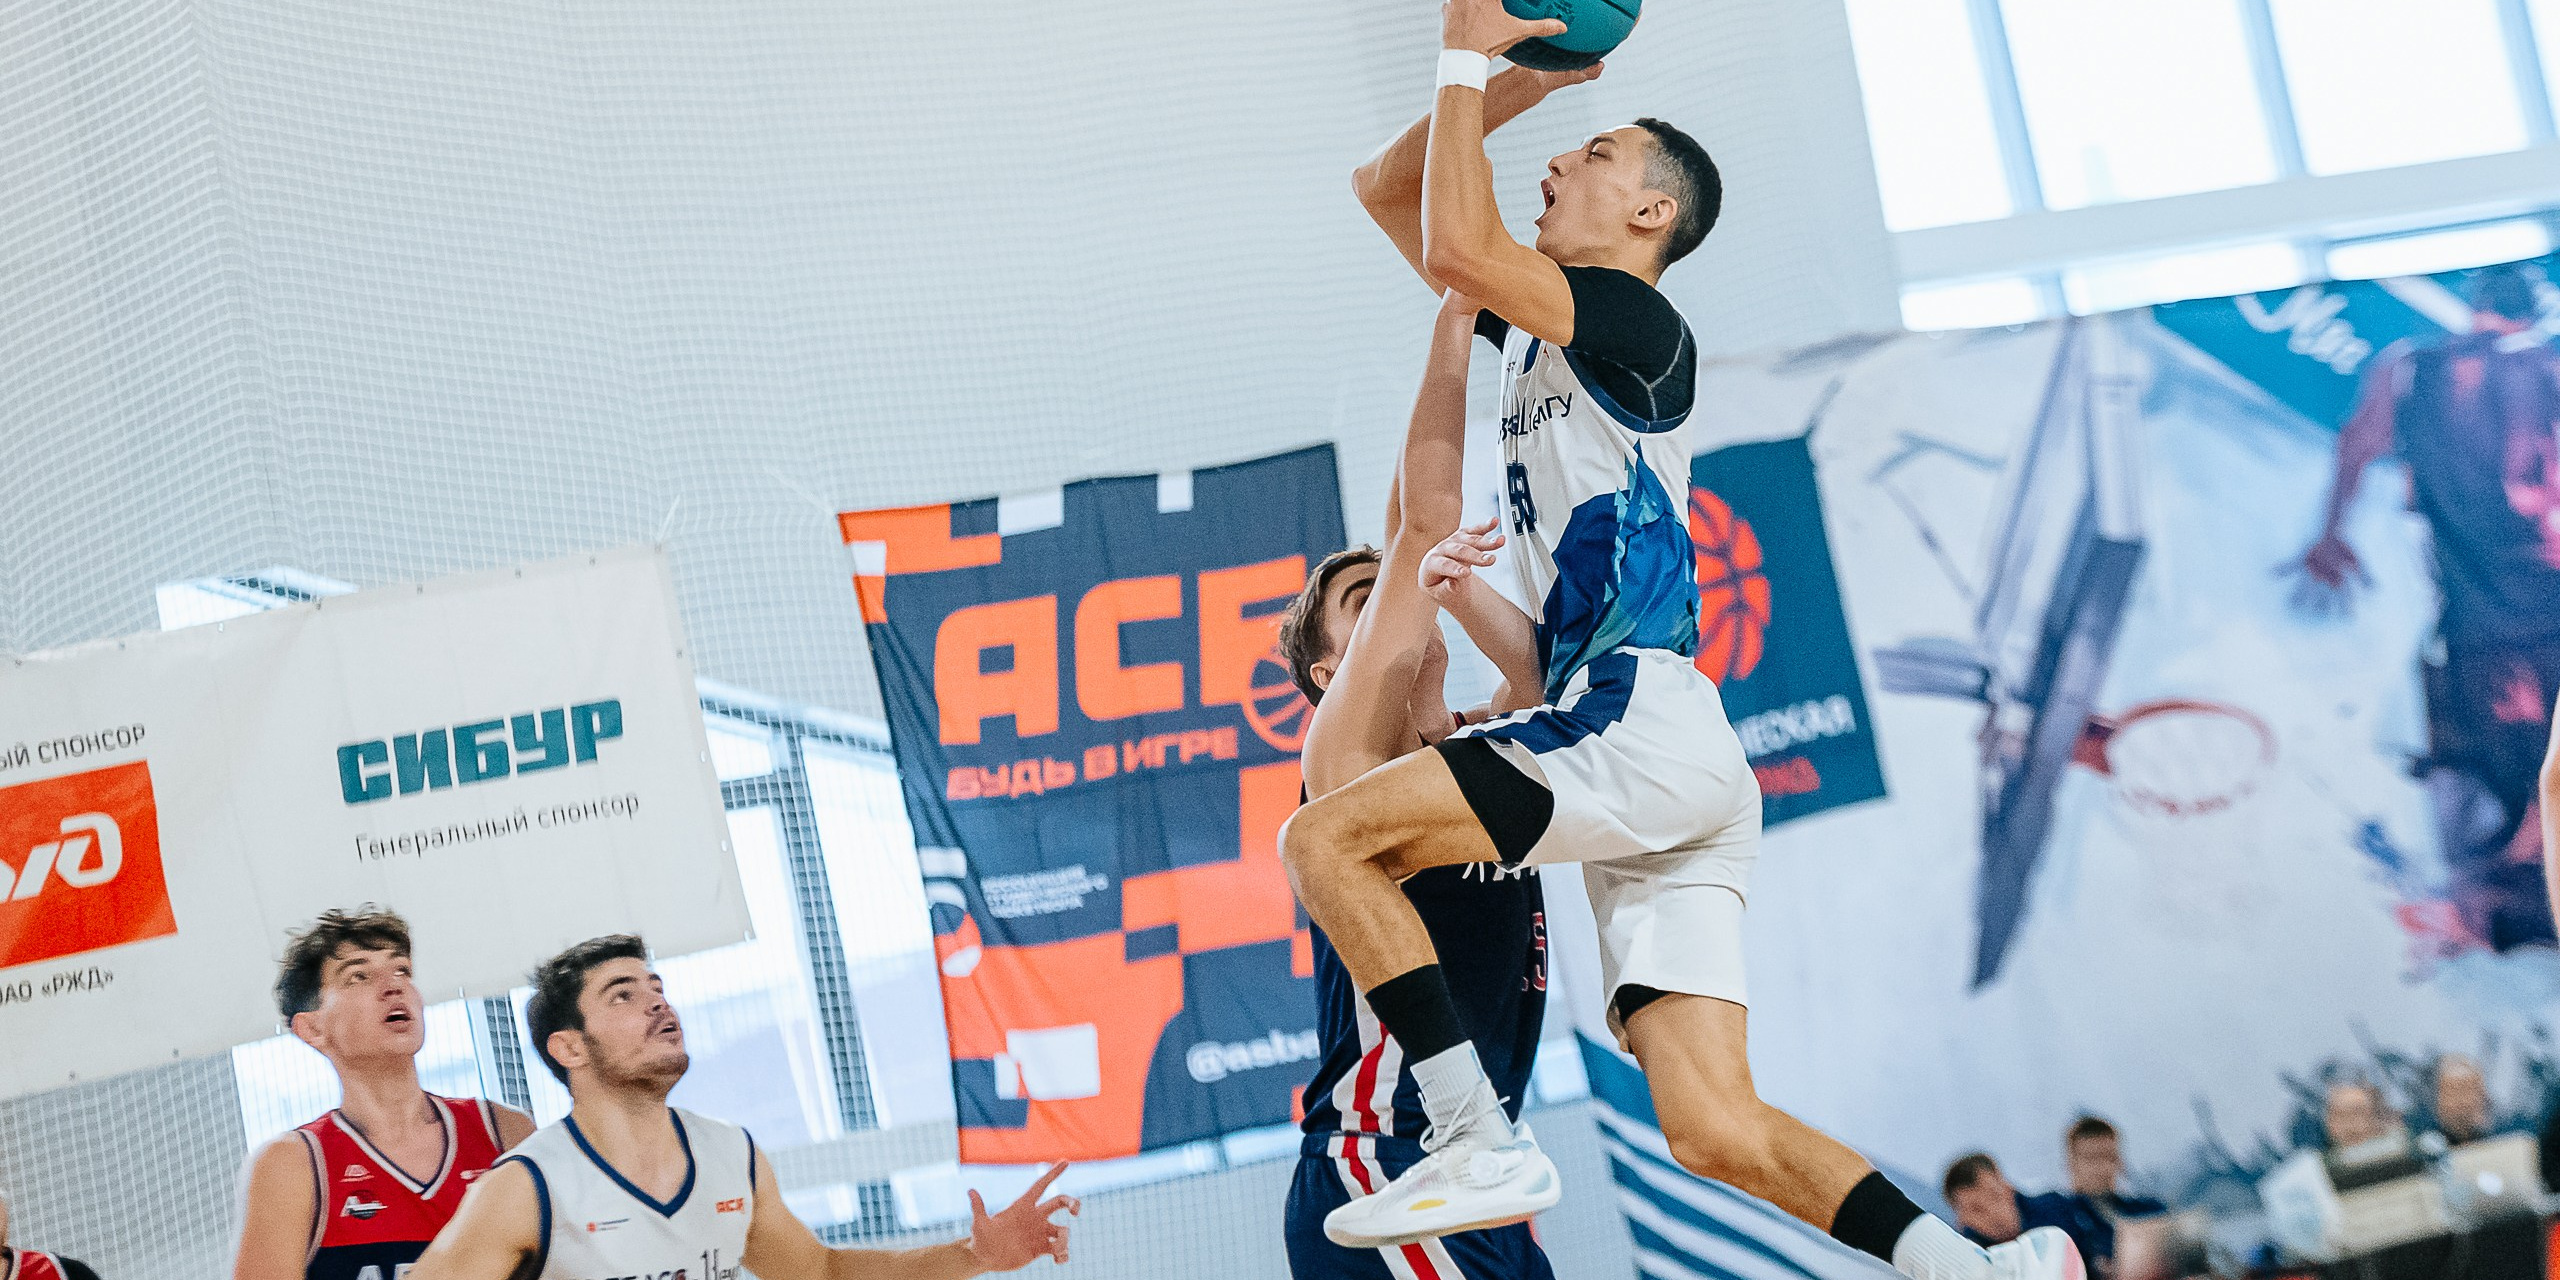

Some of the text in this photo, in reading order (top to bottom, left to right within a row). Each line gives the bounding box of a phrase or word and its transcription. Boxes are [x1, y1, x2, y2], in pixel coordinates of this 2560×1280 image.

[337, 697, 624, 805] СИБУР
[946, 725, 1239, 801] БУДЬ В ИГРЕ
[355, 792, 640, 863] Генеральный спонсор
[0, 965, 114, 1008] АО «РЖД»
